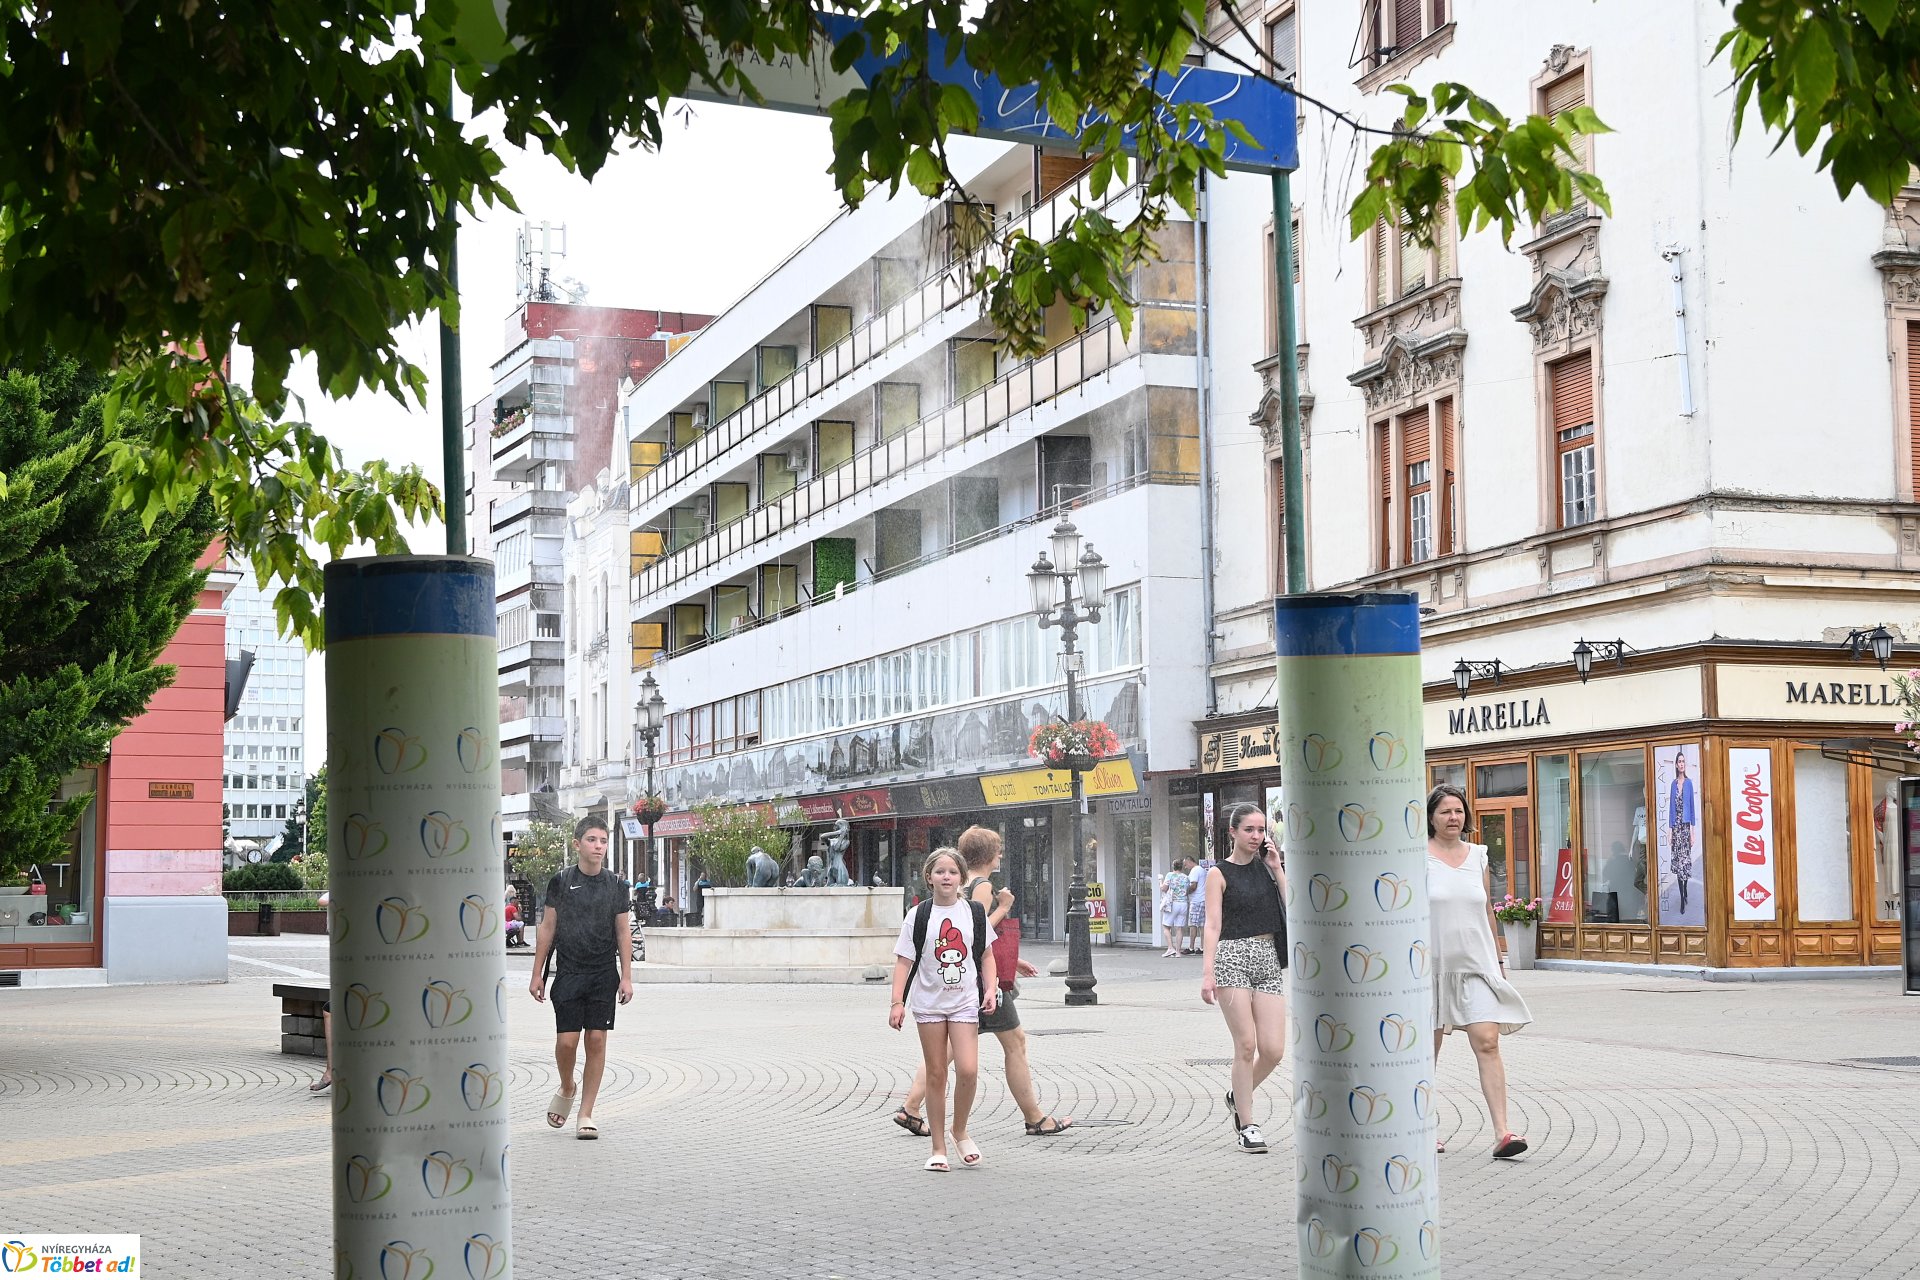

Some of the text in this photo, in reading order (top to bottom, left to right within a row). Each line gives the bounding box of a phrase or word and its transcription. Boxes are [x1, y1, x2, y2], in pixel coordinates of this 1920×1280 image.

[1785, 681, 1912, 706] MARELLA
[1448, 697, 1551, 735] MARELLA
[1239, 734, 1271, 759] Három
[992, 778, 1016, 800] bugatti
[1736, 763, 1769, 865] Lee Cooper
[1657, 760, 1670, 913] BETTY BARCLAY
[408, 867, 475, 876] NYÍREGYHÁZA
[1087, 884, 1102, 898] CIÓ
[364, 953, 435, 962] NYÍREGYHÁZA
[410, 1035, 477, 1047] NYÍREGYHÁZA
[366, 1124, 436, 1134] NYÍREGYHÁZA
[411, 1205, 480, 1218] NYÍREGYHÁZA
